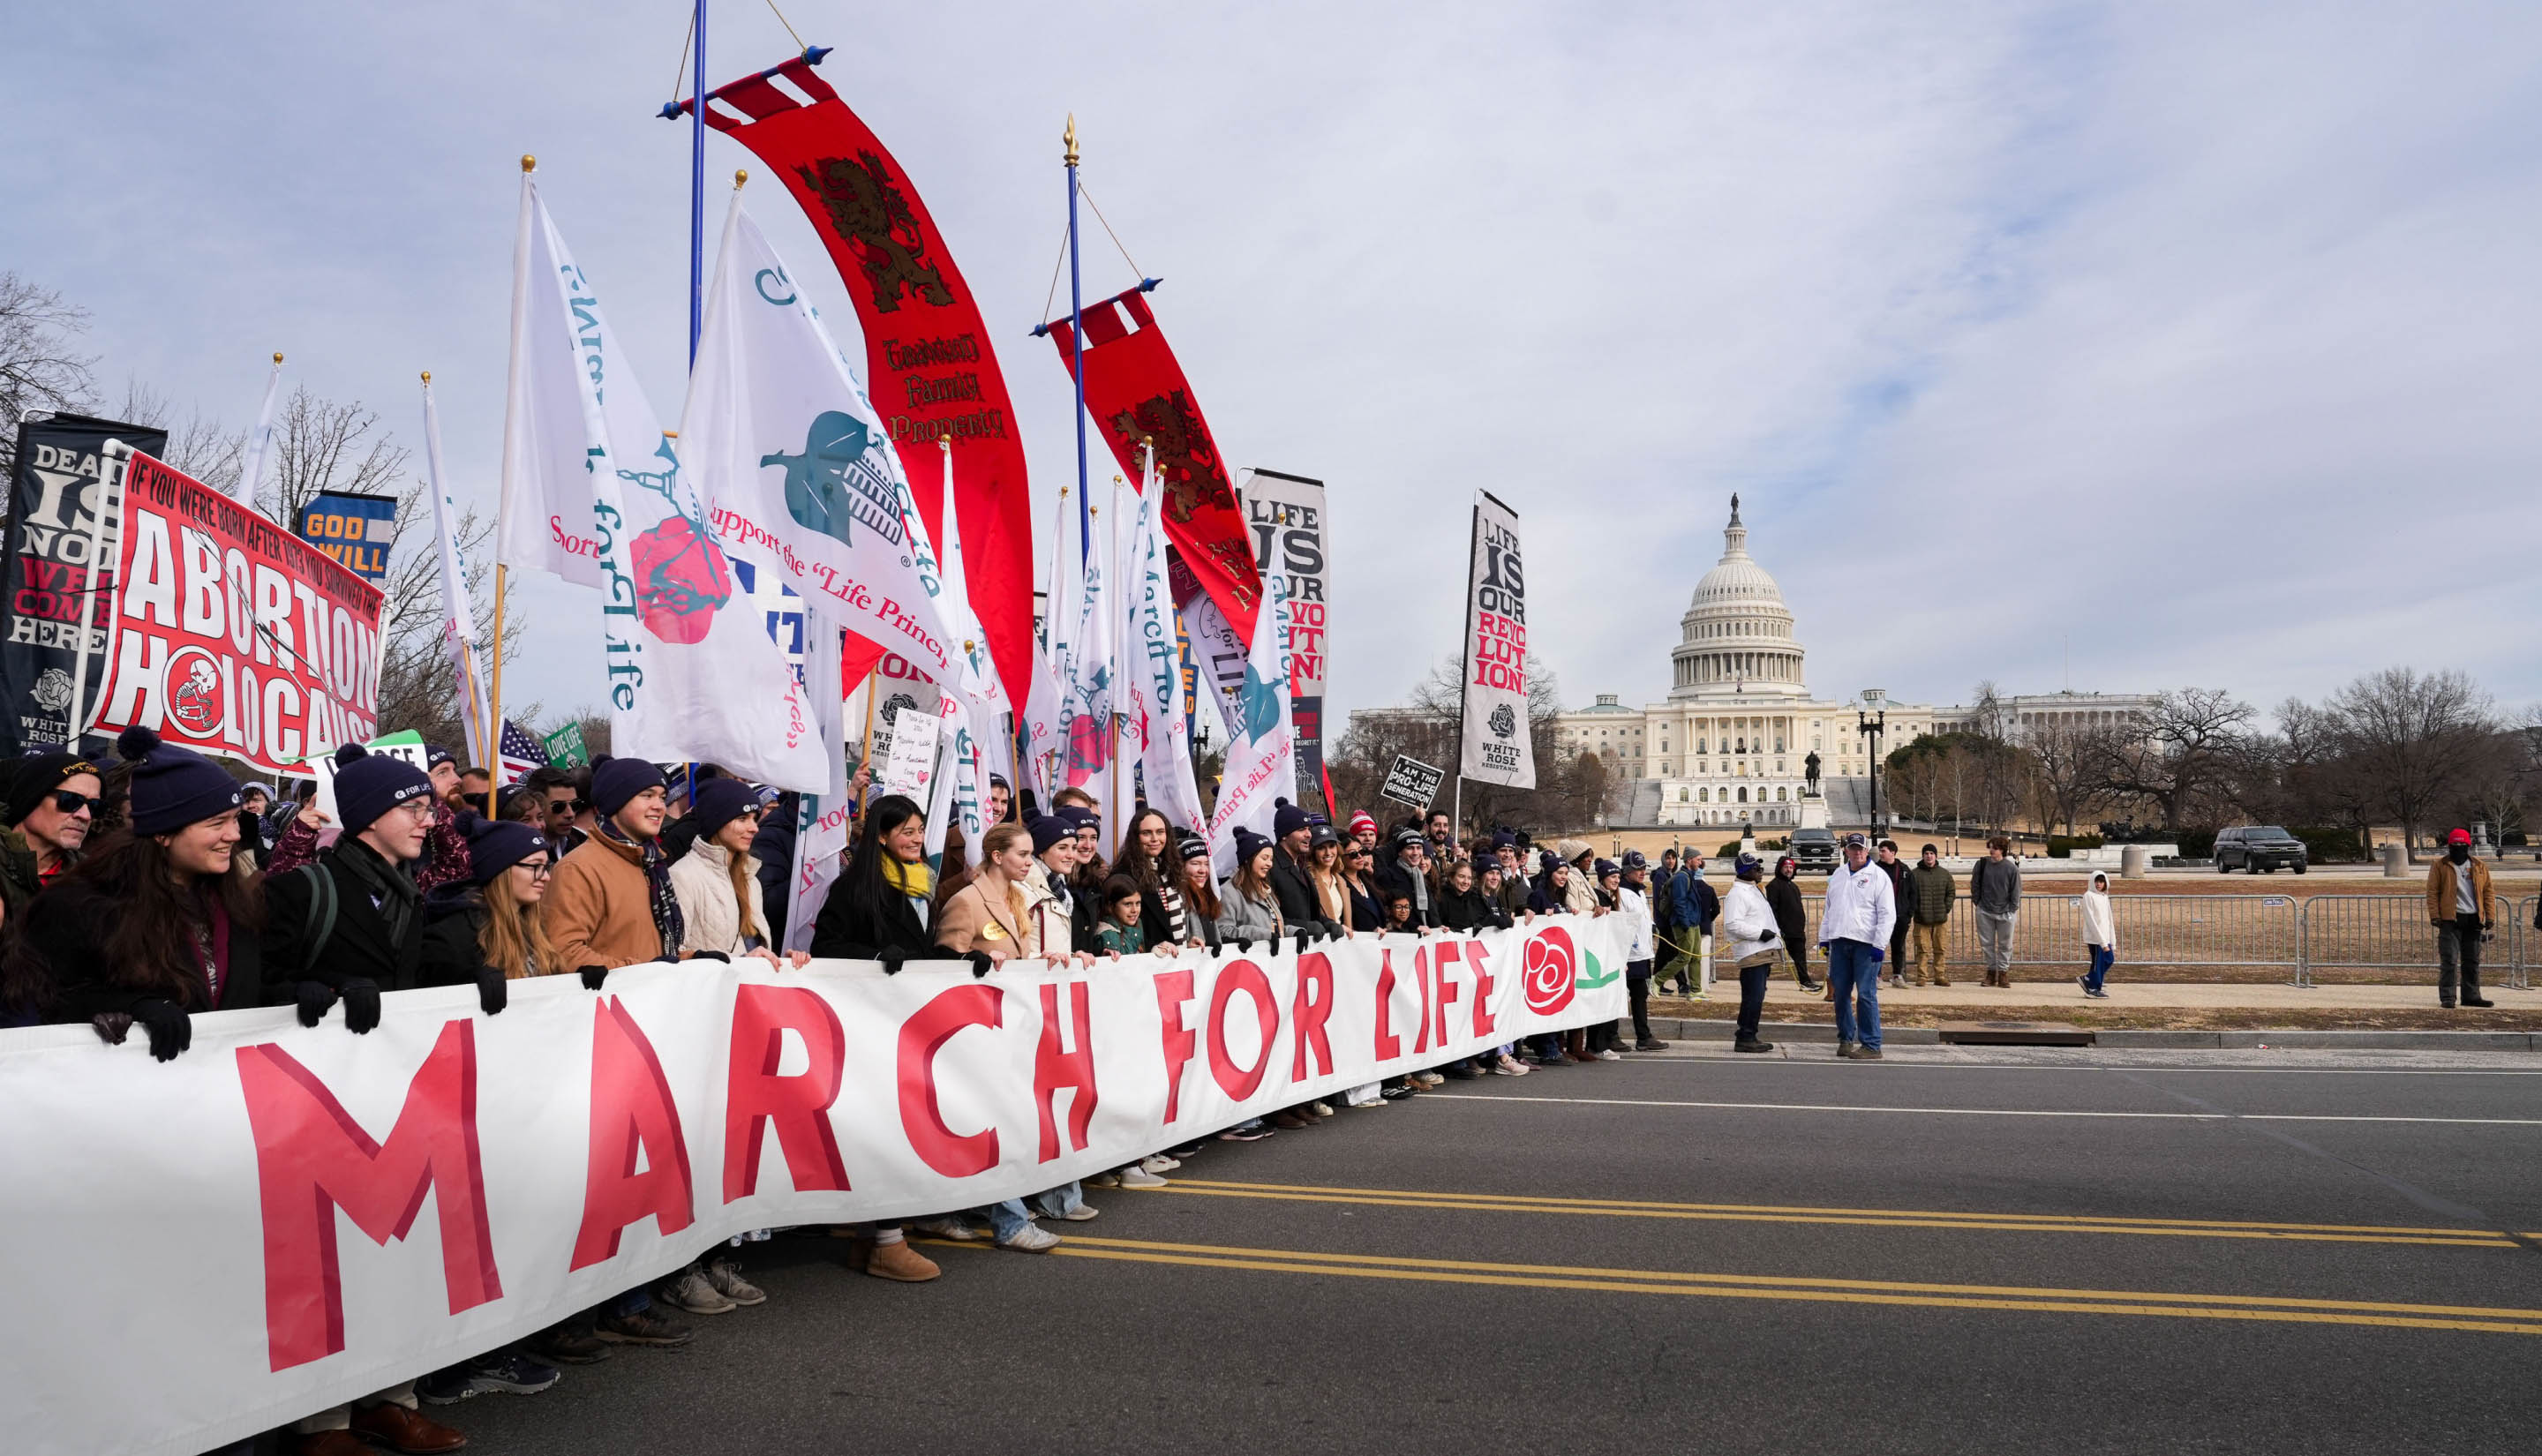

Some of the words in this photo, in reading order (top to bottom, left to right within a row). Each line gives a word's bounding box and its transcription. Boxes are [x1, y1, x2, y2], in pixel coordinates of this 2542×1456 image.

[306, 514, 364, 540] GOD
[1249, 499, 1319, 530] LIFE
[131, 461, 148, 494] IF
[149, 468, 177, 509] YOU
[179, 482, 216, 527] WERE
[217, 501, 246, 544] BORN
[247, 519, 282, 563] AFTER
[283, 539, 305, 574] 1973
[305, 552, 322, 586] YOU
[324, 564, 363, 611] SURVIVED
[364, 589, 379, 621] THE
[593, 499, 621, 570] for
[1484, 517, 1521, 558] LIFE
[783, 544, 805, 577] the
[1481, 542, 1524, 599] IS
[124, 507, 377, 716] ABORTION
[1478, 586, 1525, 626] OUR
[1221, 628, 1234, 648] for
[1477, 611, 1526, 648] REVO
[1476, 634, 1525, 672] LUT
[1473, 660, 1527, 697] ION!
[545, 733, 570, 761] LOVE
[564, 725, 583, 752] LIFE
[1482, 742, 1521, 757] WHITE
[1486, 753, 1516, 766] ROSE
[1389, 770, 1436, 796] PRO-LIFE
[1403, 767, 1418, 777] AM
[1421, 772, 1437, 784] THE
[1481, 762, 1519, 773] RESISTANCE
[405, 784, 420, 796] FOR
[1386, 782, 1431, 804] GENERATION
[235, 981, 1099, 1373] MARCH
[1153, 952, 1335, 1126] FOR
[1374, 939, 1497, 1062] LIFE
